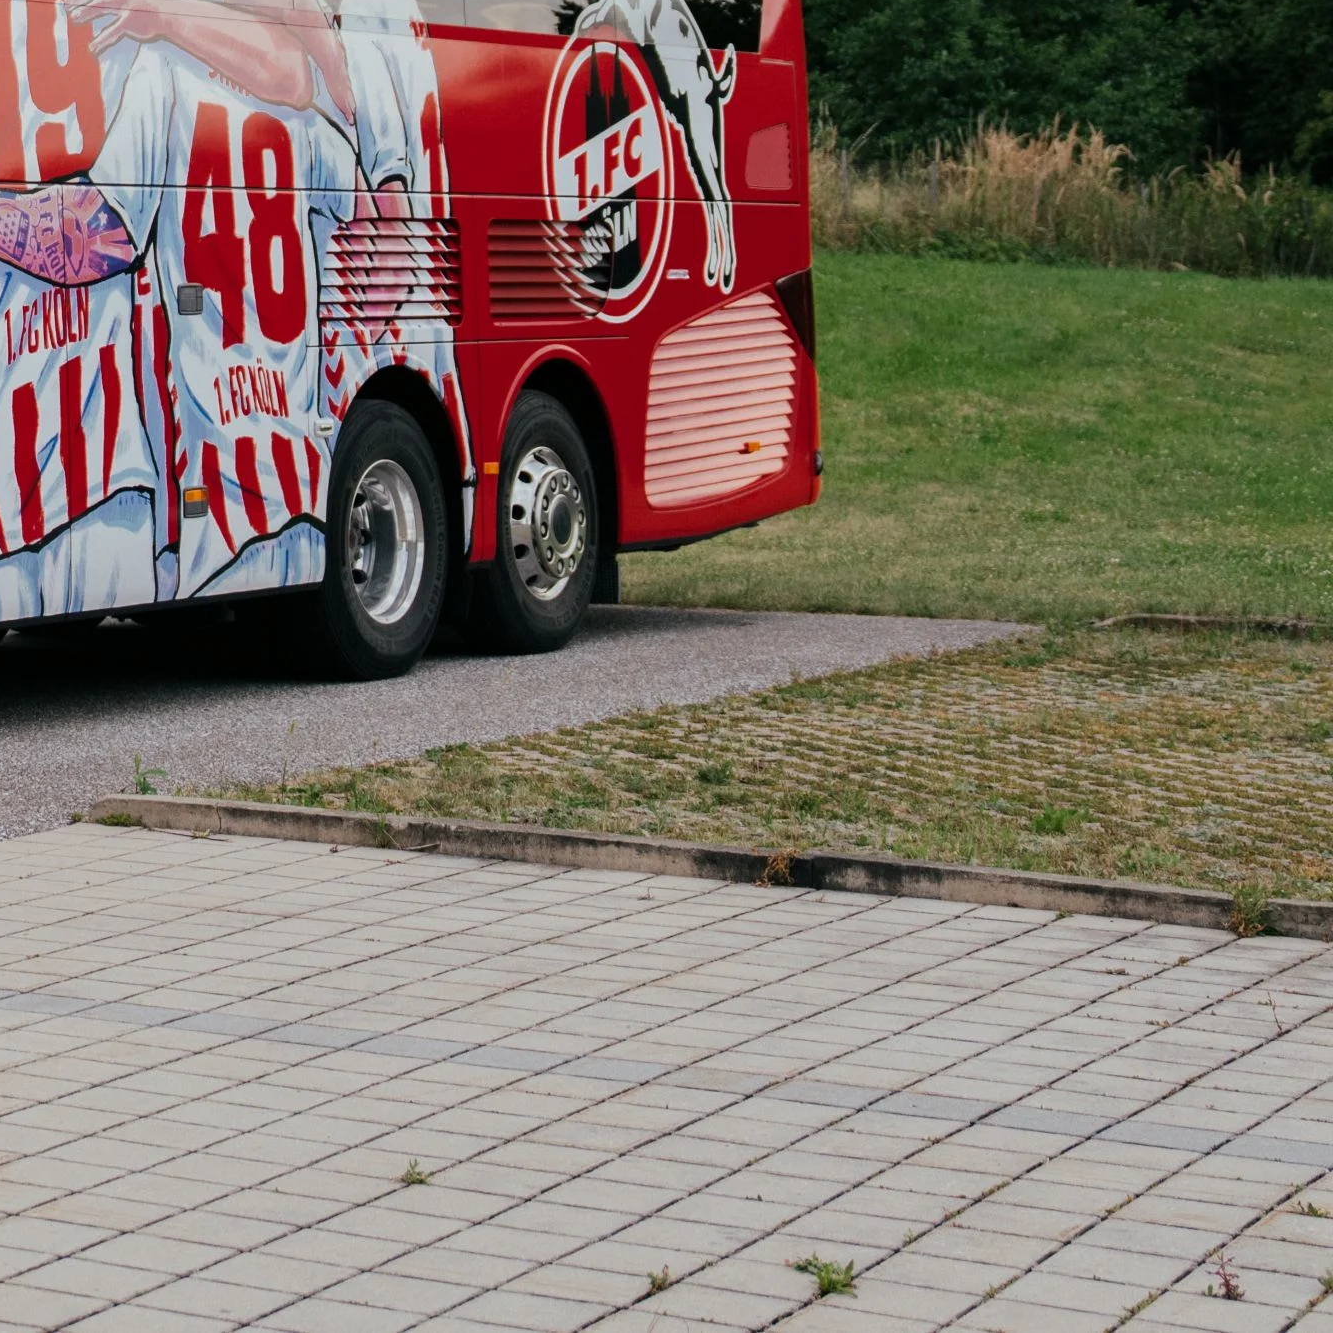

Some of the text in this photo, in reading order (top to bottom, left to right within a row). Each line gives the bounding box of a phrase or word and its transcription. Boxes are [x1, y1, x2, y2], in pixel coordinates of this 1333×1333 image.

[182, 101, 307, 351] 48
[5, 308, 17, 365] 1.
[19, 299, 39, 356] FC
[213, 357, 289, 426] 1. FC KÖLN
